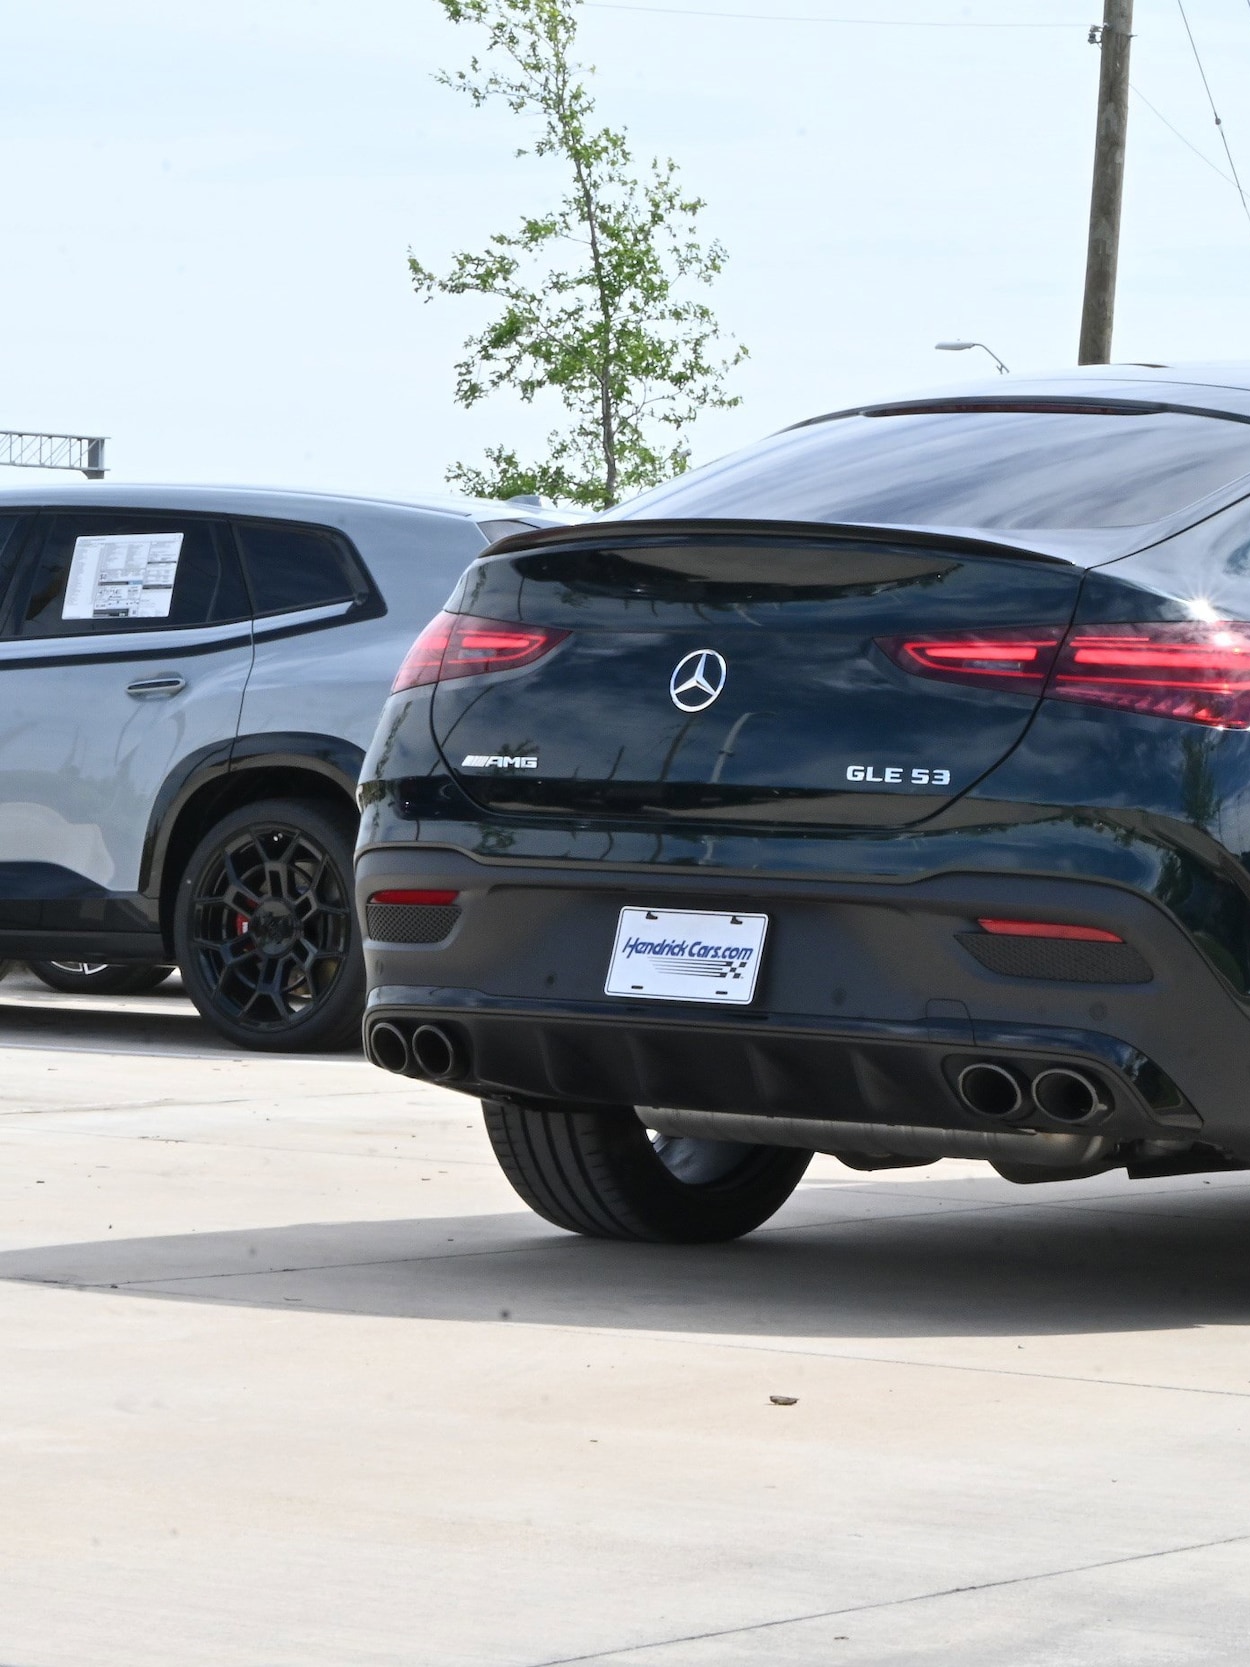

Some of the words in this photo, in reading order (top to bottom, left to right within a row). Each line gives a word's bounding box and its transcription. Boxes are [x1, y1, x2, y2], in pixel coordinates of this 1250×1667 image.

[485, 755, 538, 769] AMG
[846, 765, 903, 783] GLE
[911, 768, 951, 785] 53
